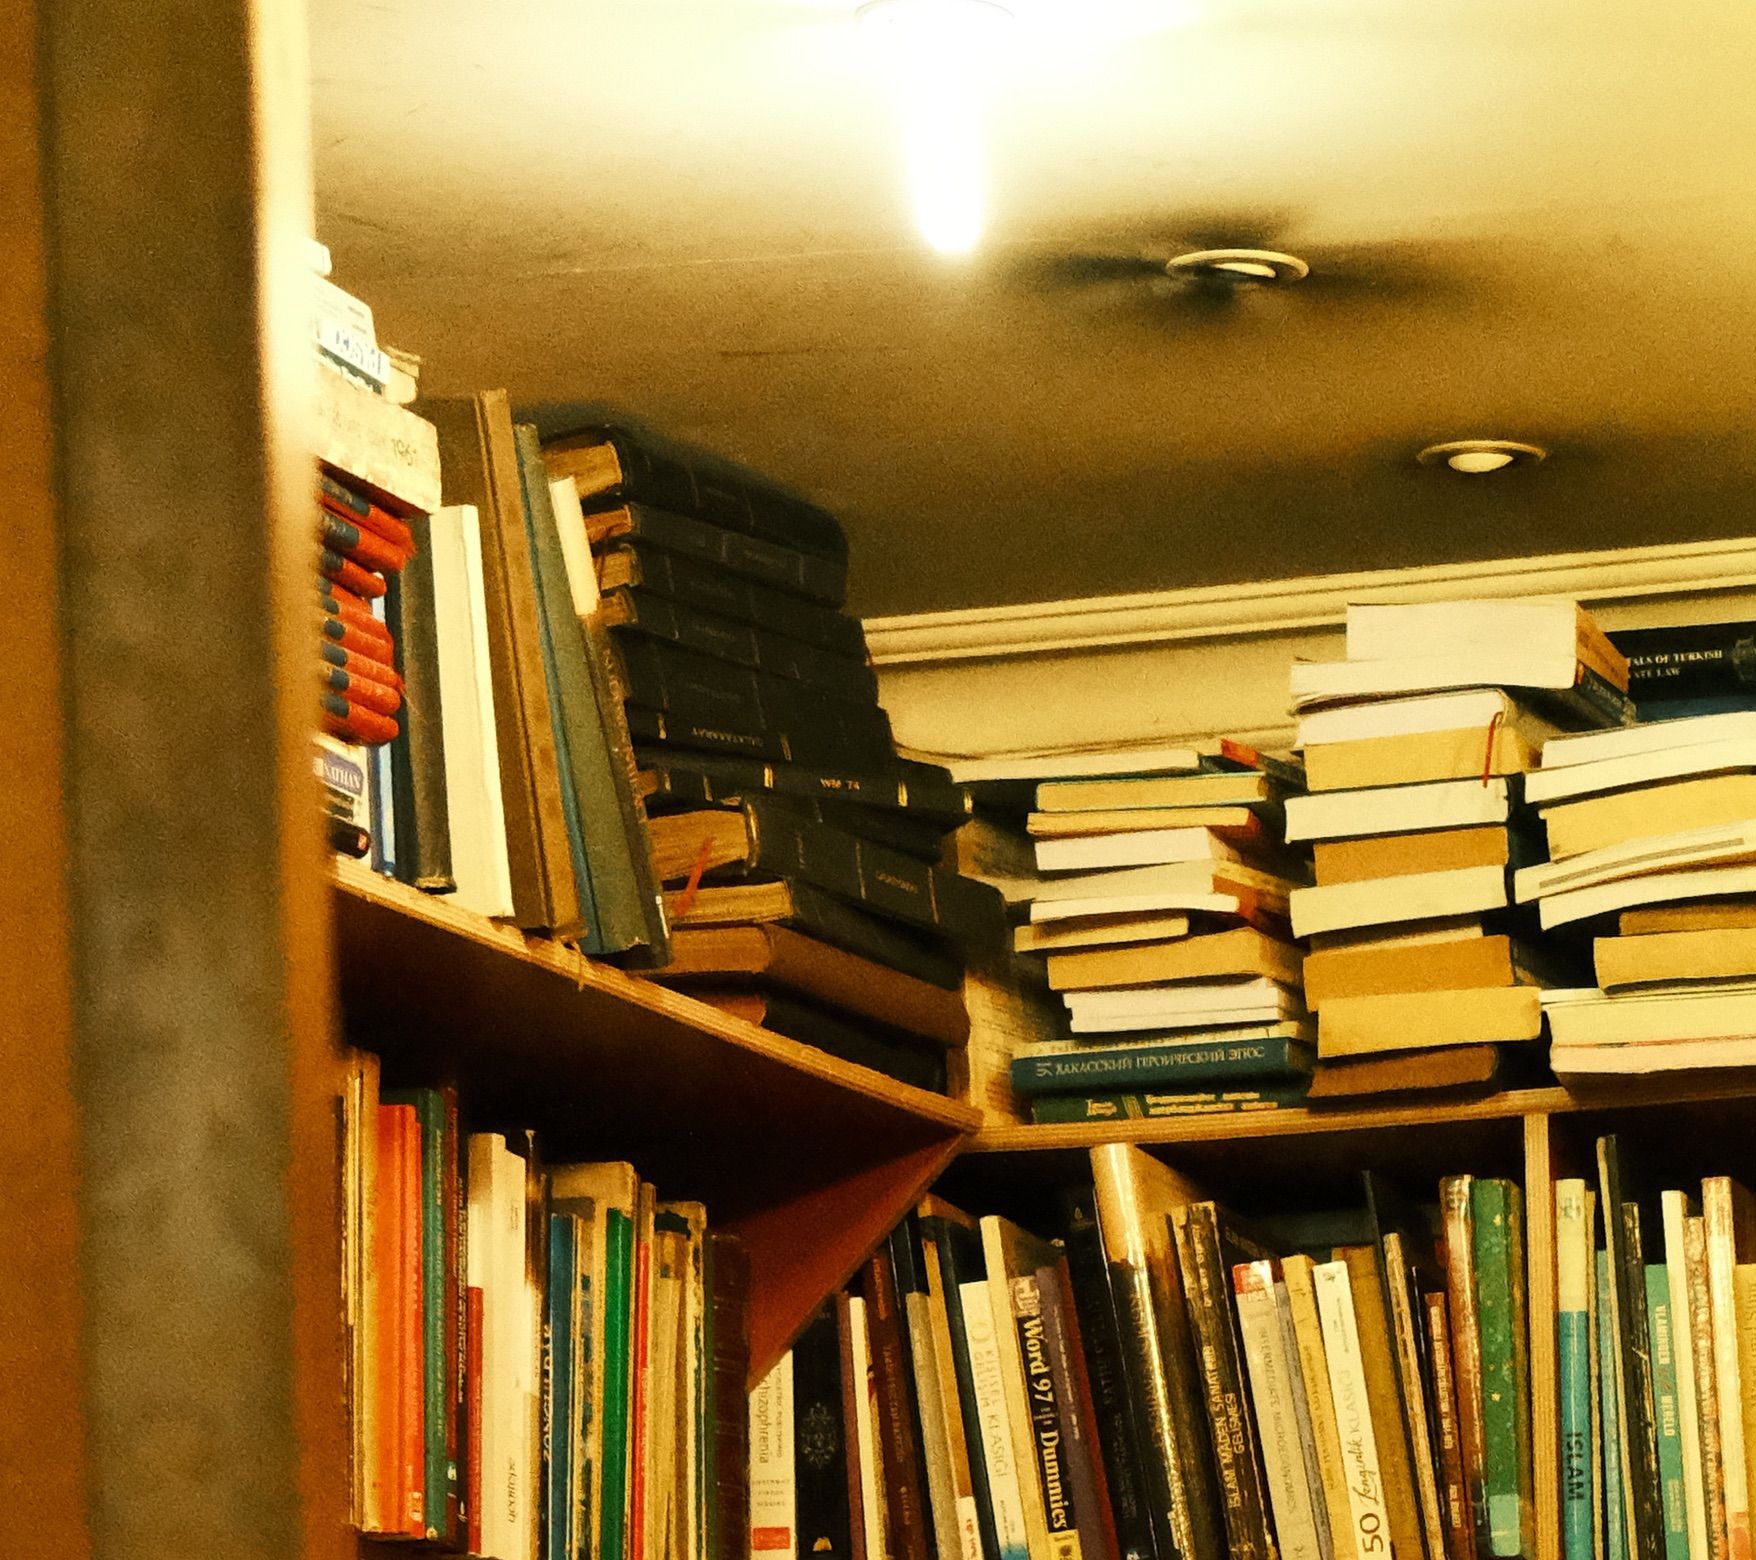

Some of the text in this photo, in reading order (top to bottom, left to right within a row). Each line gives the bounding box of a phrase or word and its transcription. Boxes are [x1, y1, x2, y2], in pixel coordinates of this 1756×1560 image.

[1673, 649, 1723, 664] TURKISH
[1022, 1317, 1071, 1530] Word 97 Dummies
[1359, 1513, 1384, 1553] 50
